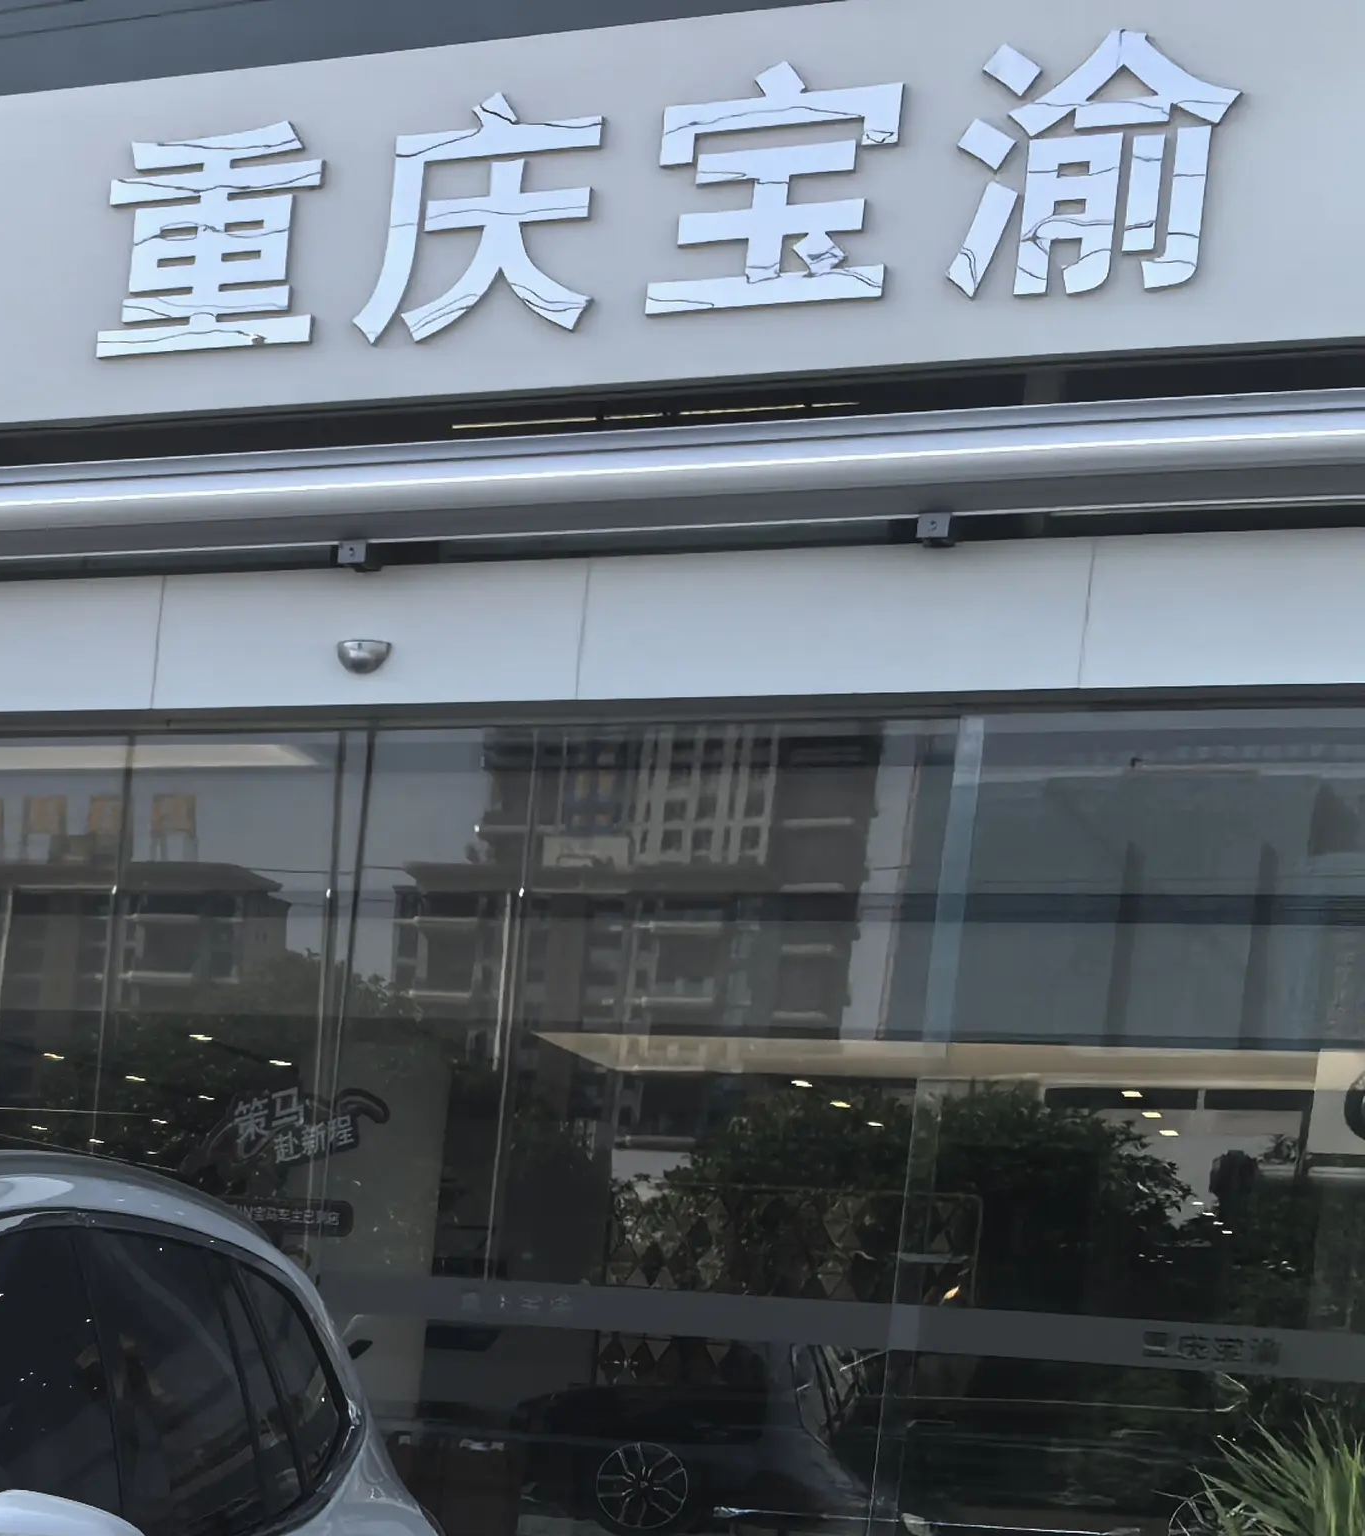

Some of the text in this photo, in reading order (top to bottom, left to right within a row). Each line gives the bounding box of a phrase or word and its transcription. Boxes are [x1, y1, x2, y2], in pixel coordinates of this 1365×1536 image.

[95, 28, 1241, 361] 重庆宝渝
[234, 1087, 305, 1141] 策马
[273, 1114, 356, 1165] 赴新程
